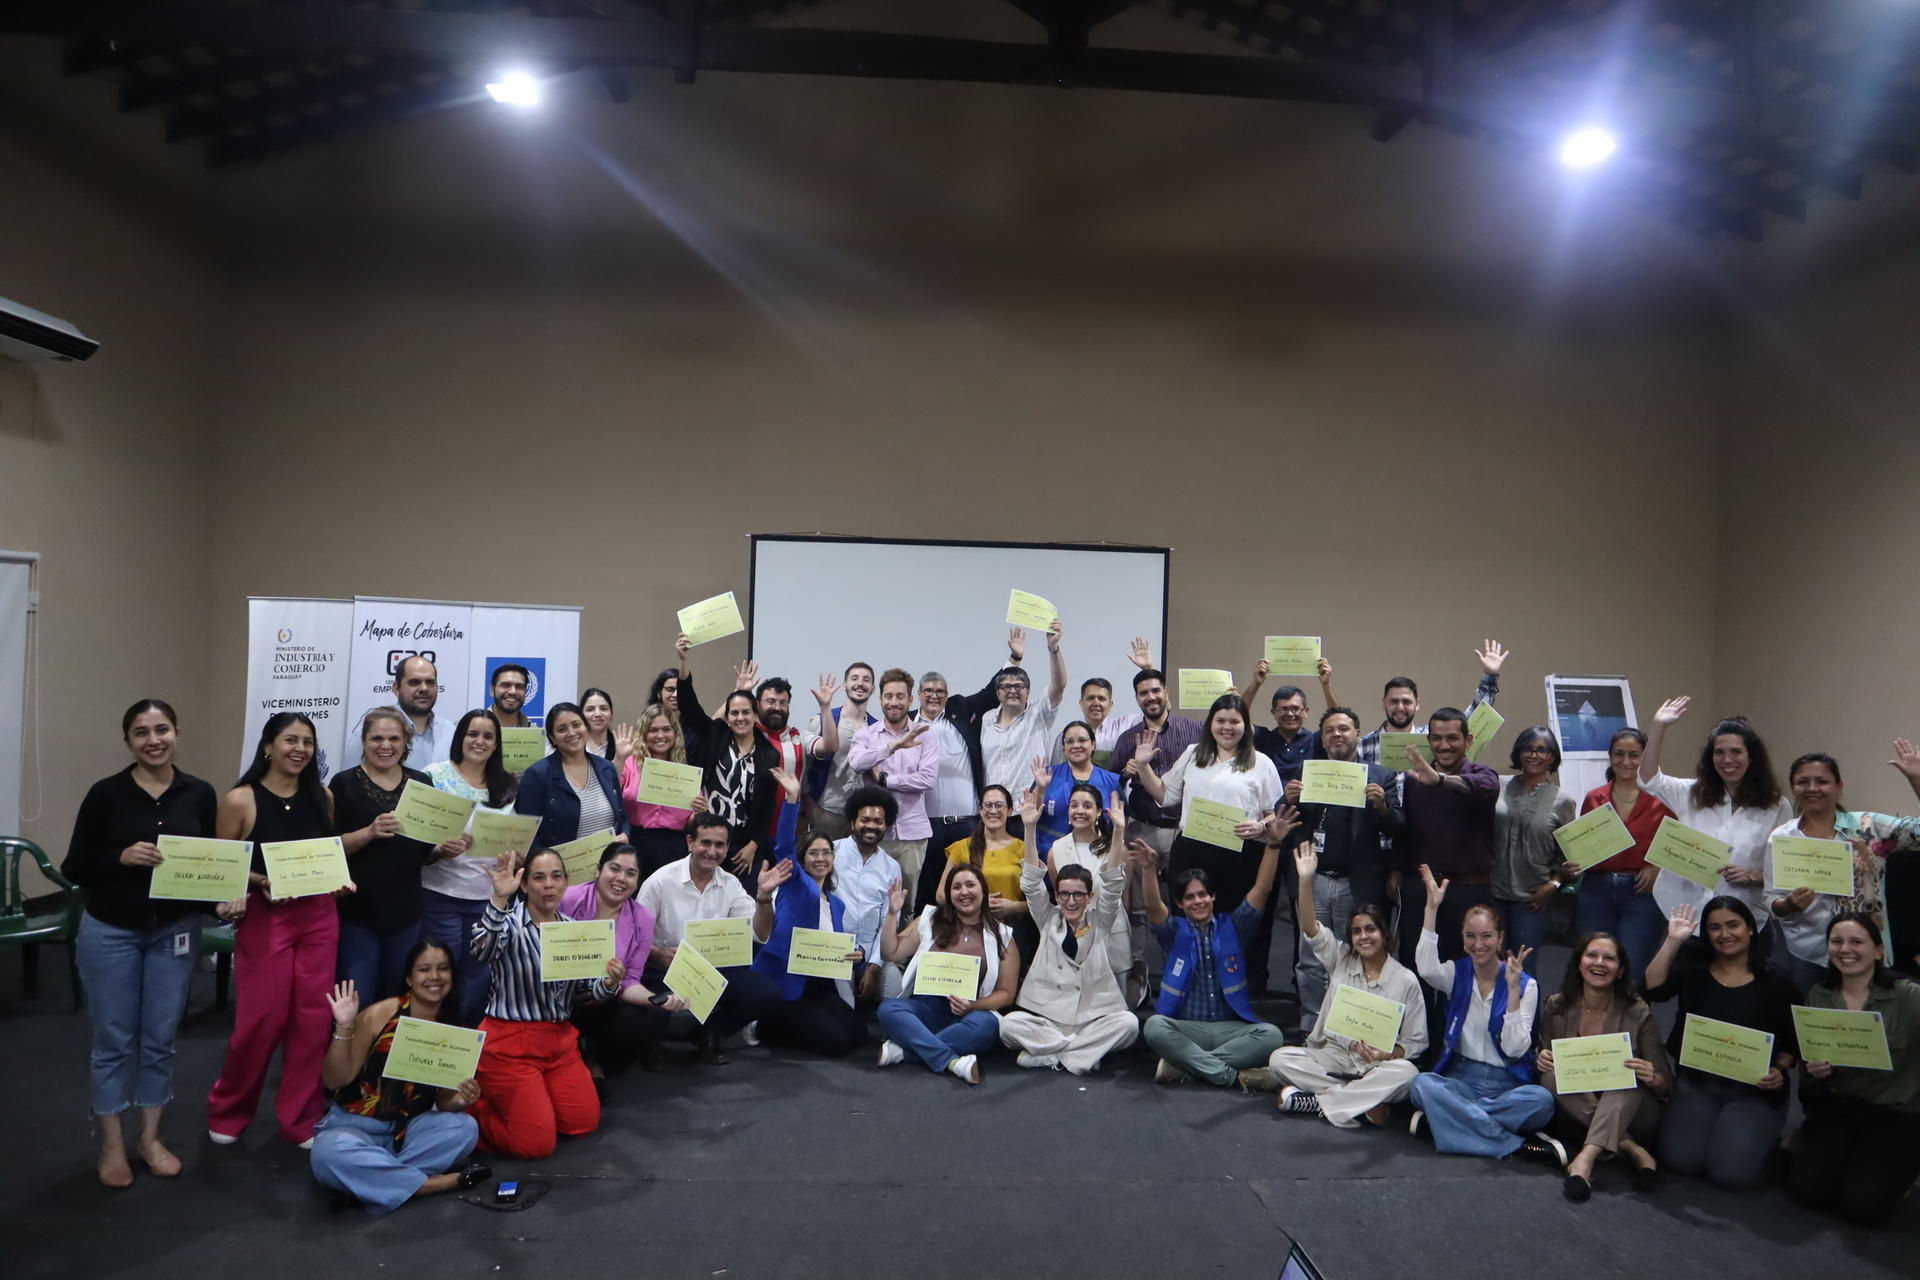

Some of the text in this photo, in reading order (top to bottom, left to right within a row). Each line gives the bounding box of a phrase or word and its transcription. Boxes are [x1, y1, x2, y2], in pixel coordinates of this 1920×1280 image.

[360, 619, 464, 642] Mapa de Cobertura
[275, 653, 335, 662] INDUSTRIA Y
[273, 664, 325, 673] COMERCIO
[262, 697, 340, 709] VICEMINISTERIO
